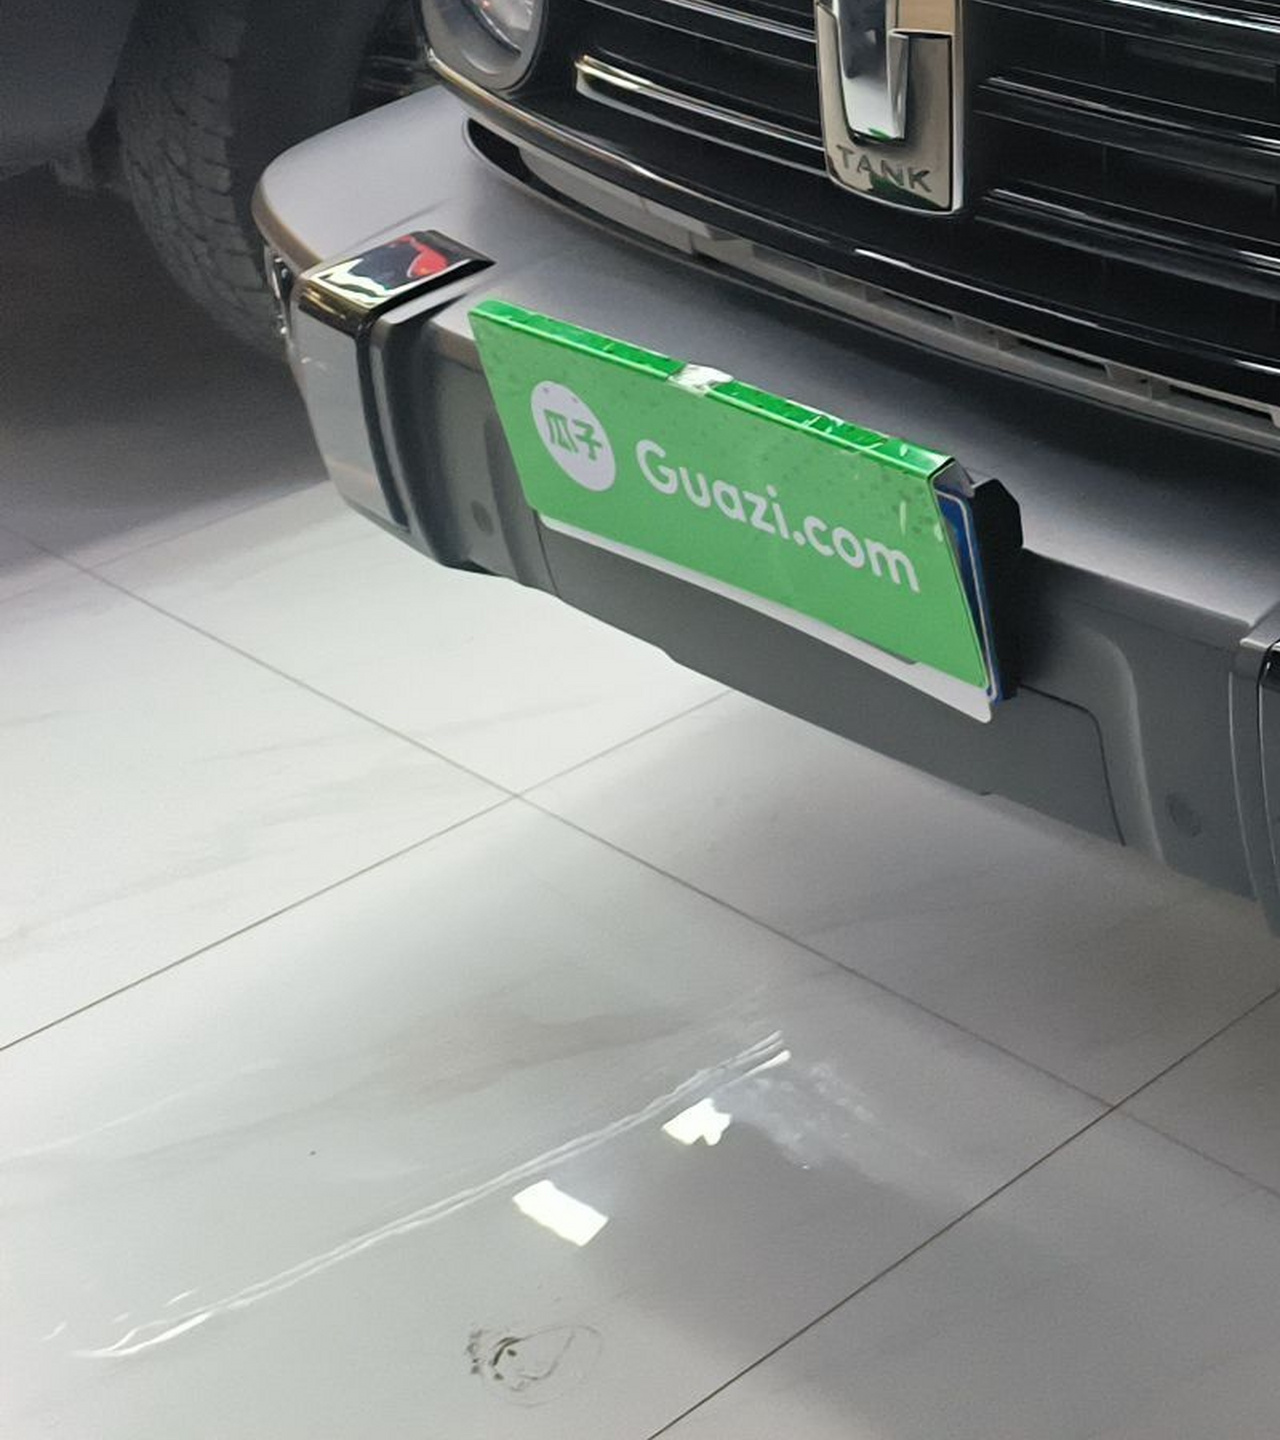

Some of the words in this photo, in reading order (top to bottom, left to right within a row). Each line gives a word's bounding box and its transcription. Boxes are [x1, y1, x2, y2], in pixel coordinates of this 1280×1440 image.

[835, 143, 932, 194] TANK
[541, 408, 604, 462] 瓜子
[635, 438, 921, 593] Guazi.com
